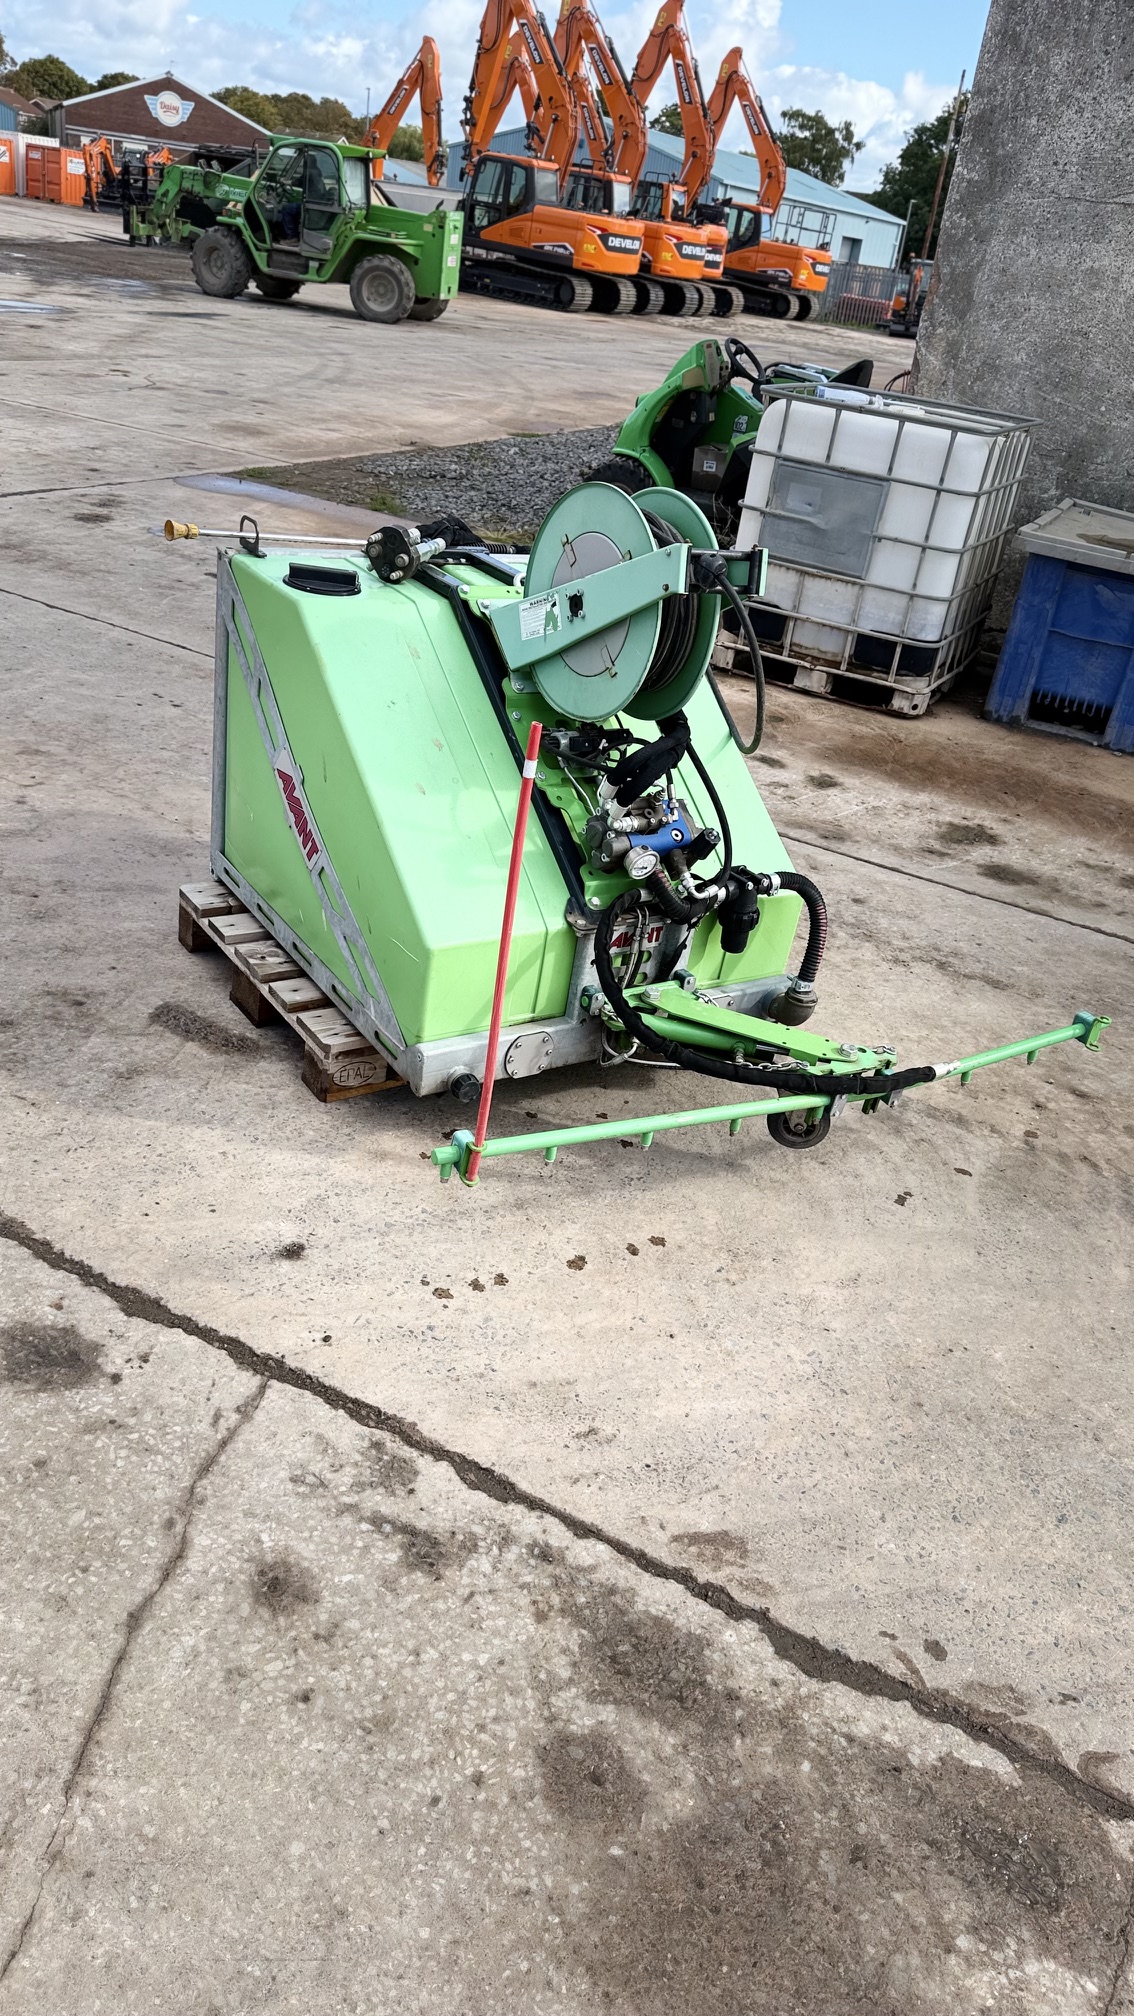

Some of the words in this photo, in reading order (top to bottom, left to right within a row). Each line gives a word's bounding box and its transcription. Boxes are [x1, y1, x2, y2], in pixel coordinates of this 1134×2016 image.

[523, 25, 541, 63] DEVELON
[592, 49, 610, 85] DEVELON
[677, 66, 690, 103] DEVELON
[159, 101, 180, 114] Daisy
[389, 88, 407, 115] DEVELON
[582, 107, 595, 139] DEVELON
[745, 106, 759, 135] DEVELON
[277, 768, 319, 862] AVANT
[610, 926, 663, 948] AVNT
[339, 1066, 369, 1083] EPAL
